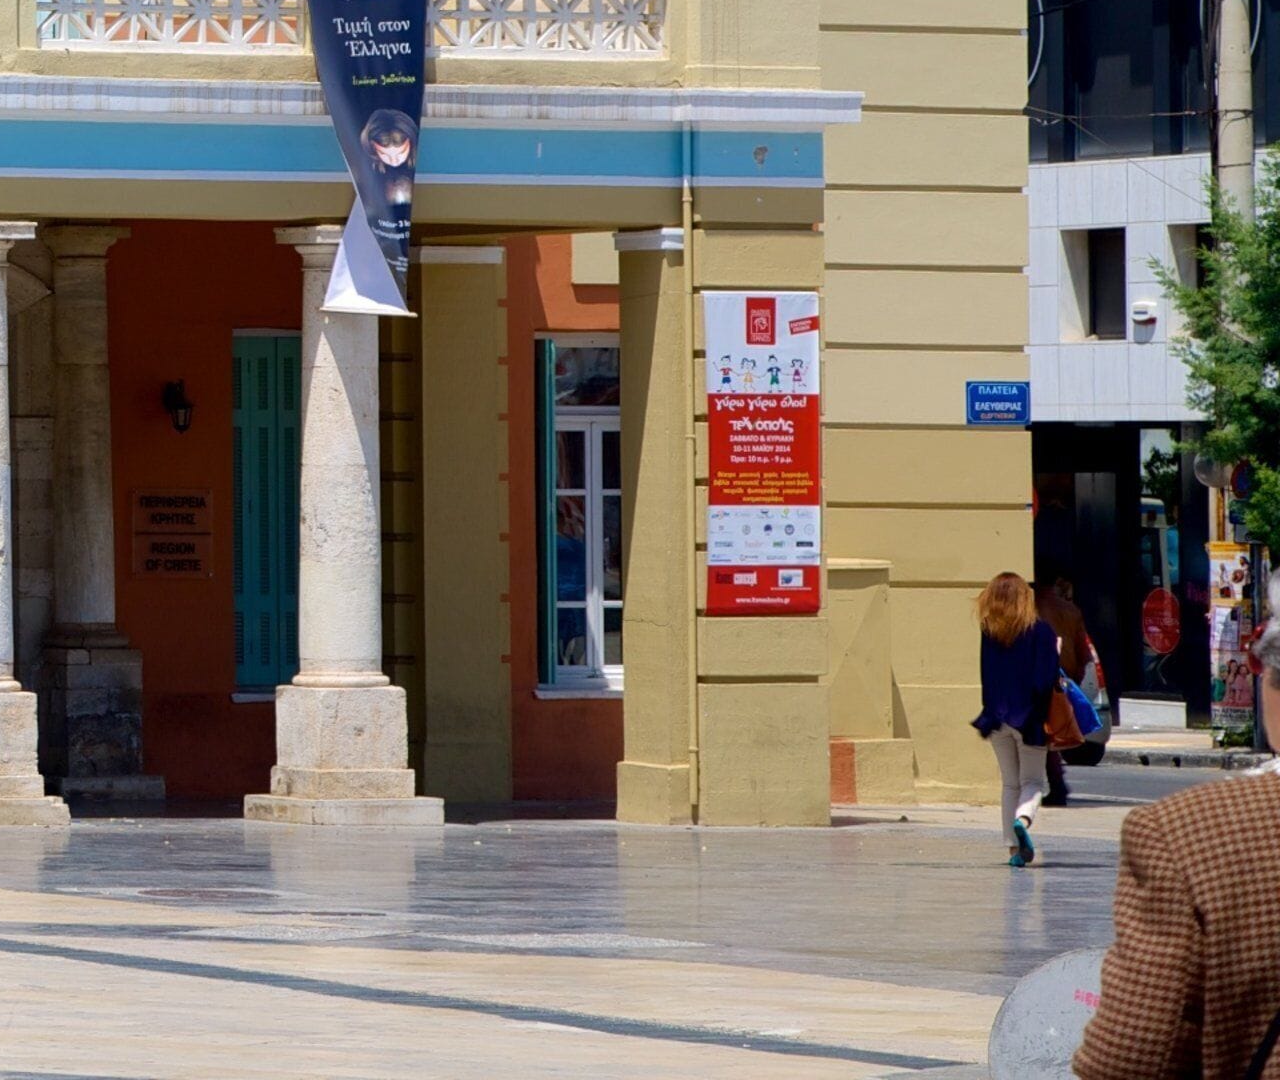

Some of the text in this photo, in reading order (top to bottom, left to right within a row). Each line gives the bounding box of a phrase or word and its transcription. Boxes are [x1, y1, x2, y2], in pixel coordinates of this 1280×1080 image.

[332, 16, 411, 38] Τιμή στον
[345, 40, 411, 60] Έλληνα
[978, 385, 1019, 395] ΠΛΑΤΕΙΑ
[151, 542, 196, 554] REGION
